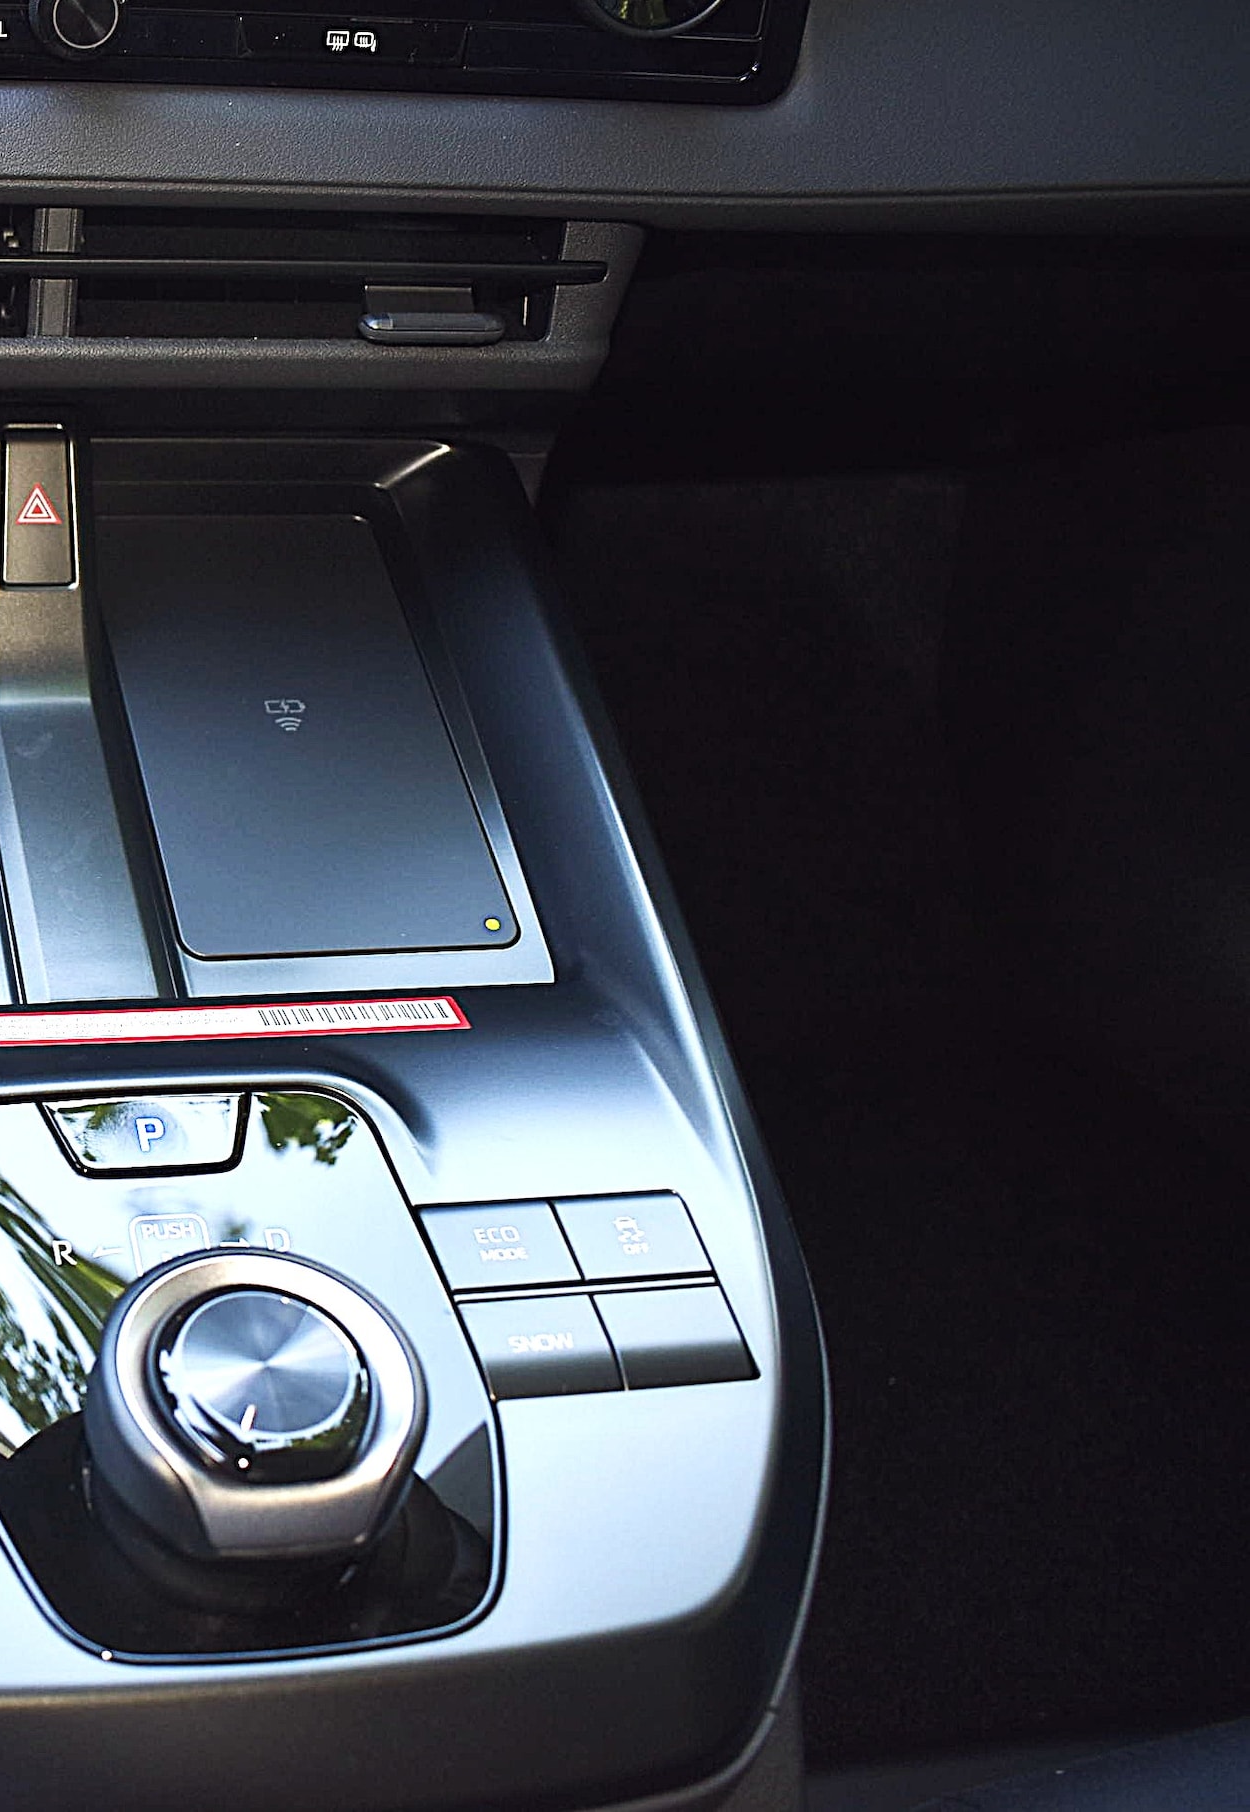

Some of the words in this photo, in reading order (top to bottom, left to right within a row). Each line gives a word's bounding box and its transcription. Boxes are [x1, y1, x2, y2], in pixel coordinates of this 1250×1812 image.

[134, 1116, 166, 1152] P
[140, 1221, 197, 1241] PUSH
[263, 1228, 291, 1252] D
[472, 1226, 520, 1244] ECO
[51, 1240, 78, 1266] R
[479, 1247, 529, 1262] MODE
[507, 1332, 575, 1354] SNOW
